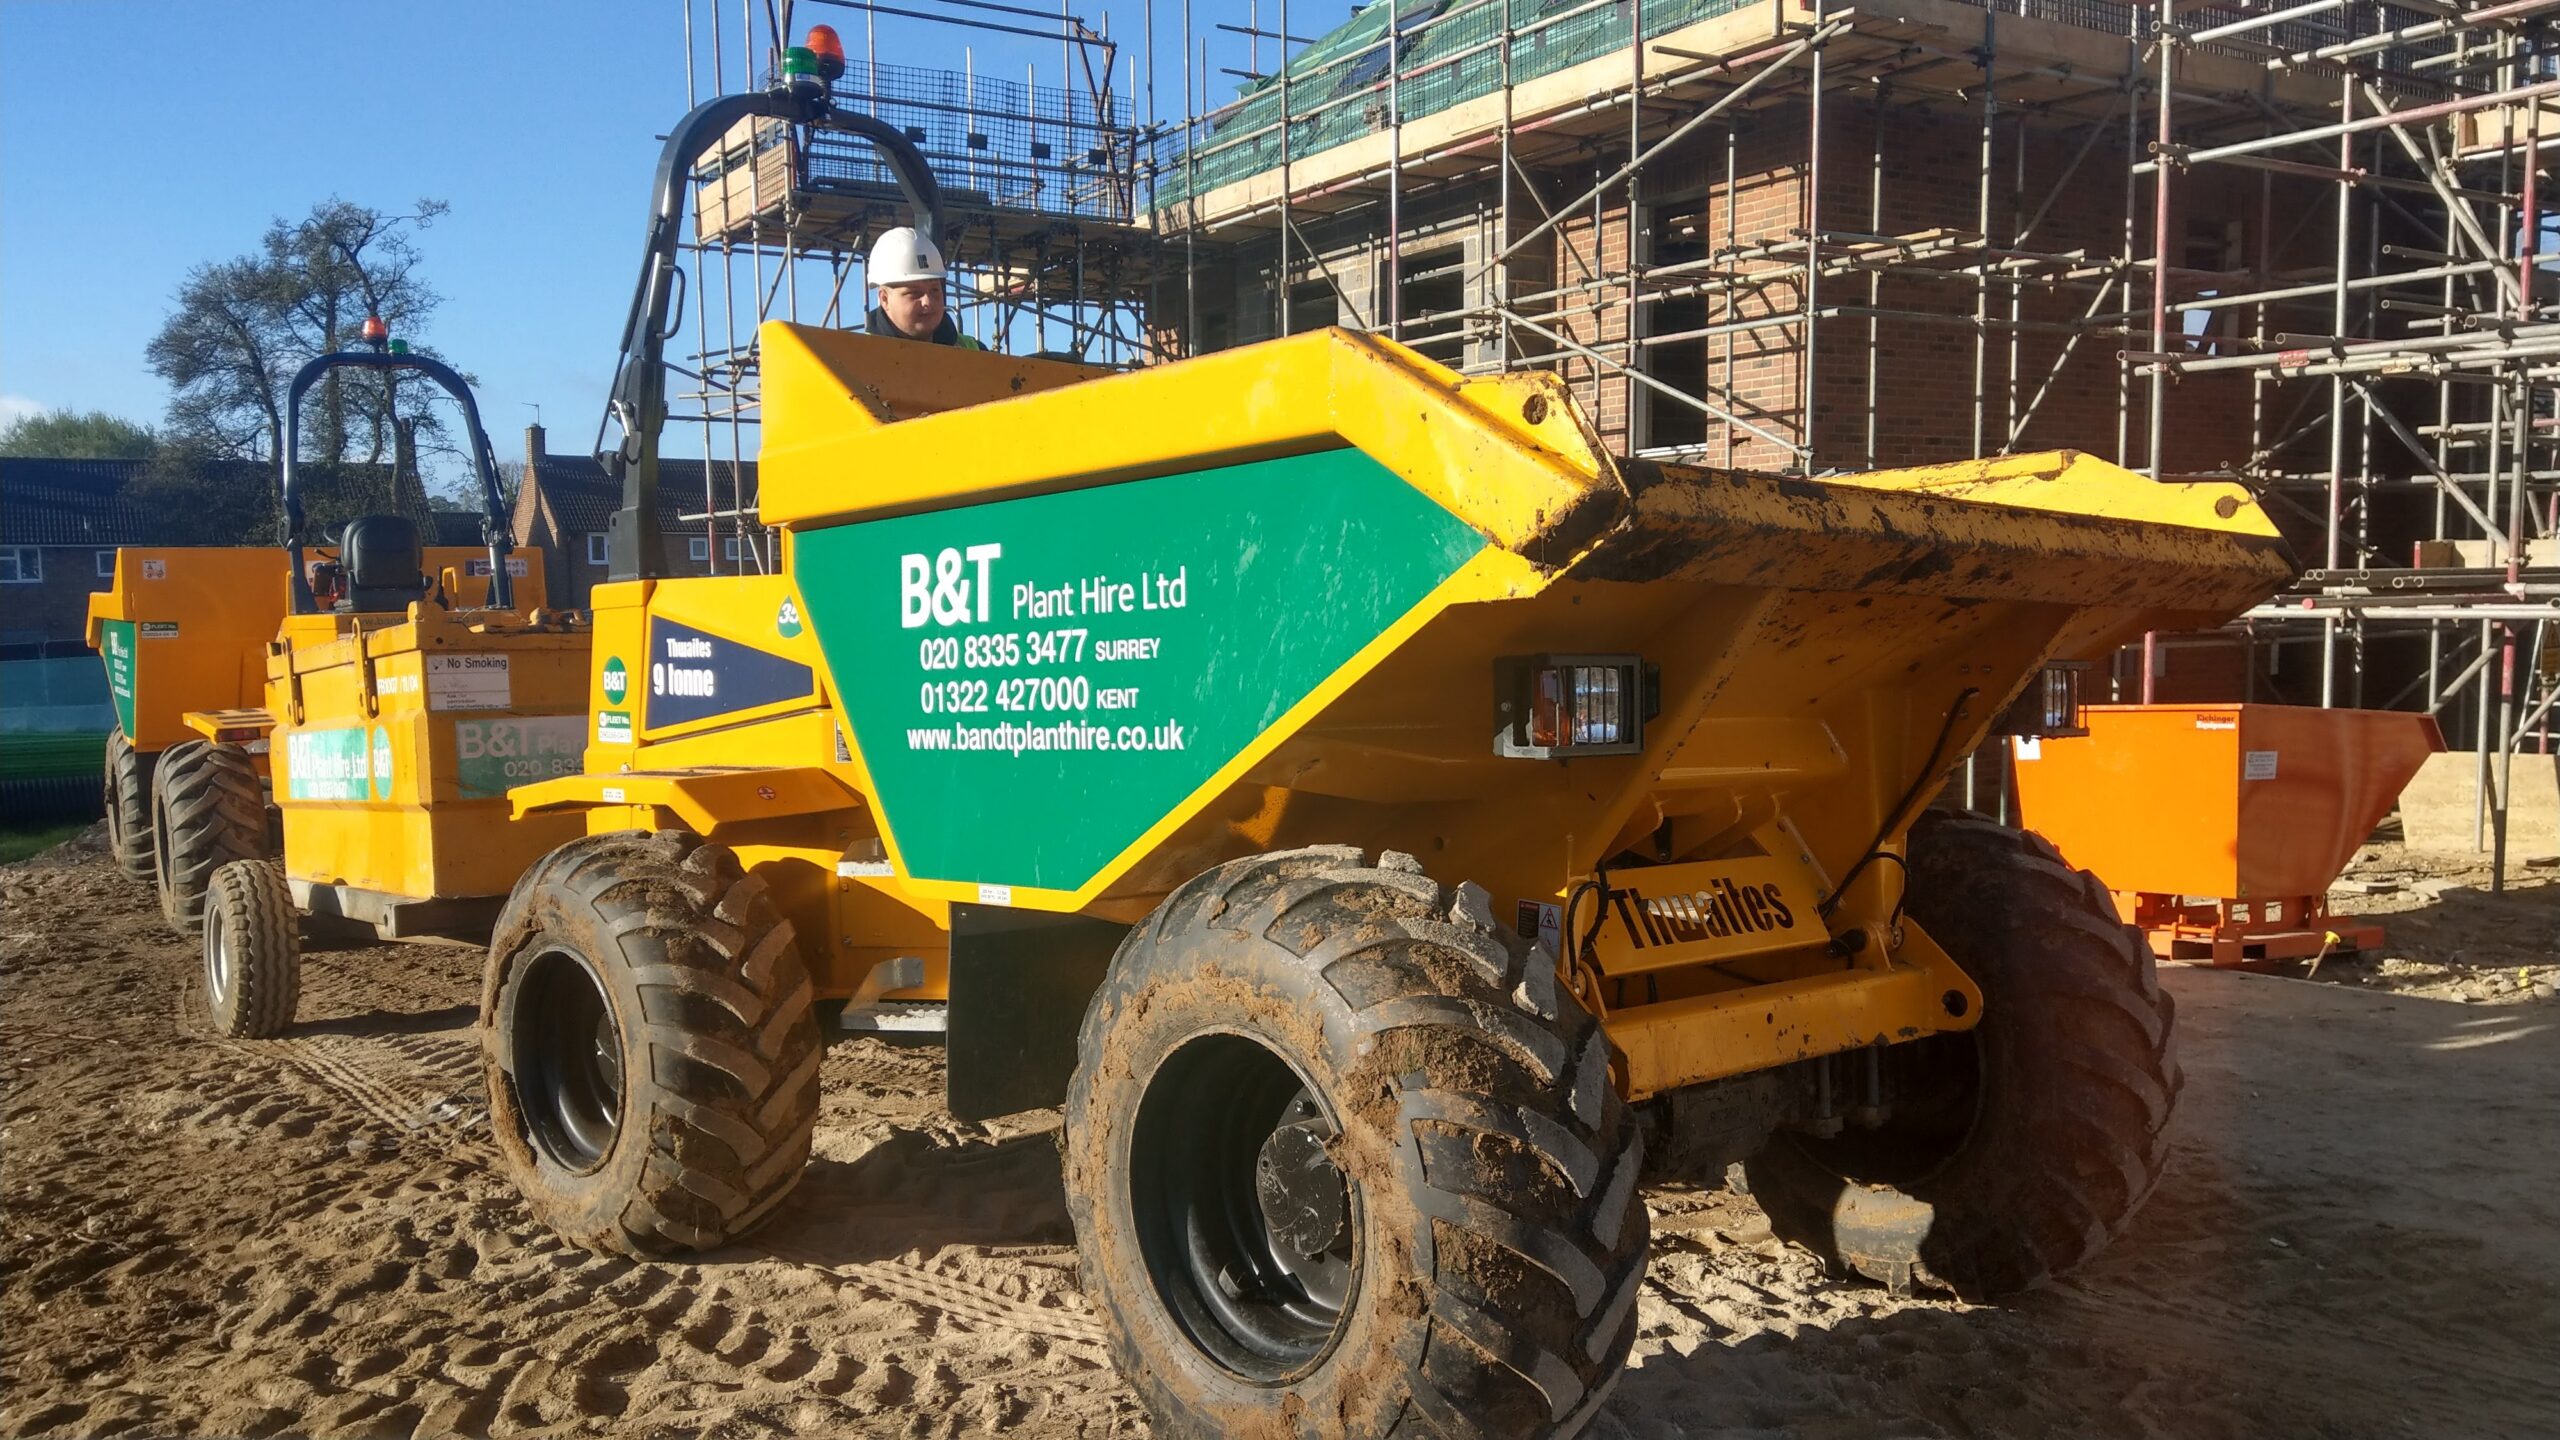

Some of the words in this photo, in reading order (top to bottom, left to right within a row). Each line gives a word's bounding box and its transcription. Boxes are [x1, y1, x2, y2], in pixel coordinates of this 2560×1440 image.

[901, 543, 1001, 628] B&T
[1013, 581, 1074, 620] Plant
[1081, 576, 1135, 615] Hire
[1142, 565, 1186, 610] Ltd
[447, 657, 460, 668] No
[465, 657, 507, 670] Smoking
[666, 638, 712, 657] Thwaites
[920, 637, 959, 670] 020
[964, 633, 1020, 668] 8335
[1026, 629, 1088, 665] 3477
[1095, 638, 1160, 661] SURREY
[603, 671, 626, 691] B&T
[653, 663, 664, 695] 9
[668, 663, 714, 696] tonne
[921, 680, 988, 713] 01322
[995, 675, 1089, 711] 427000
[1096, 688, 1139, 710] KENT
[606, 716, 621, 724] FLEET
[460, 722, 529, 759] B&T
[907, 718, 1184, 758] www.bandtplanthire.co.uk
[289, 734, 312, 779] B&T
[352, 751, 367, 778] Ltd
[373, 748, 390, 778] B&T
[504, 760, 543, 778] 020
[1608, 877, 1794, 949] Thwaites
